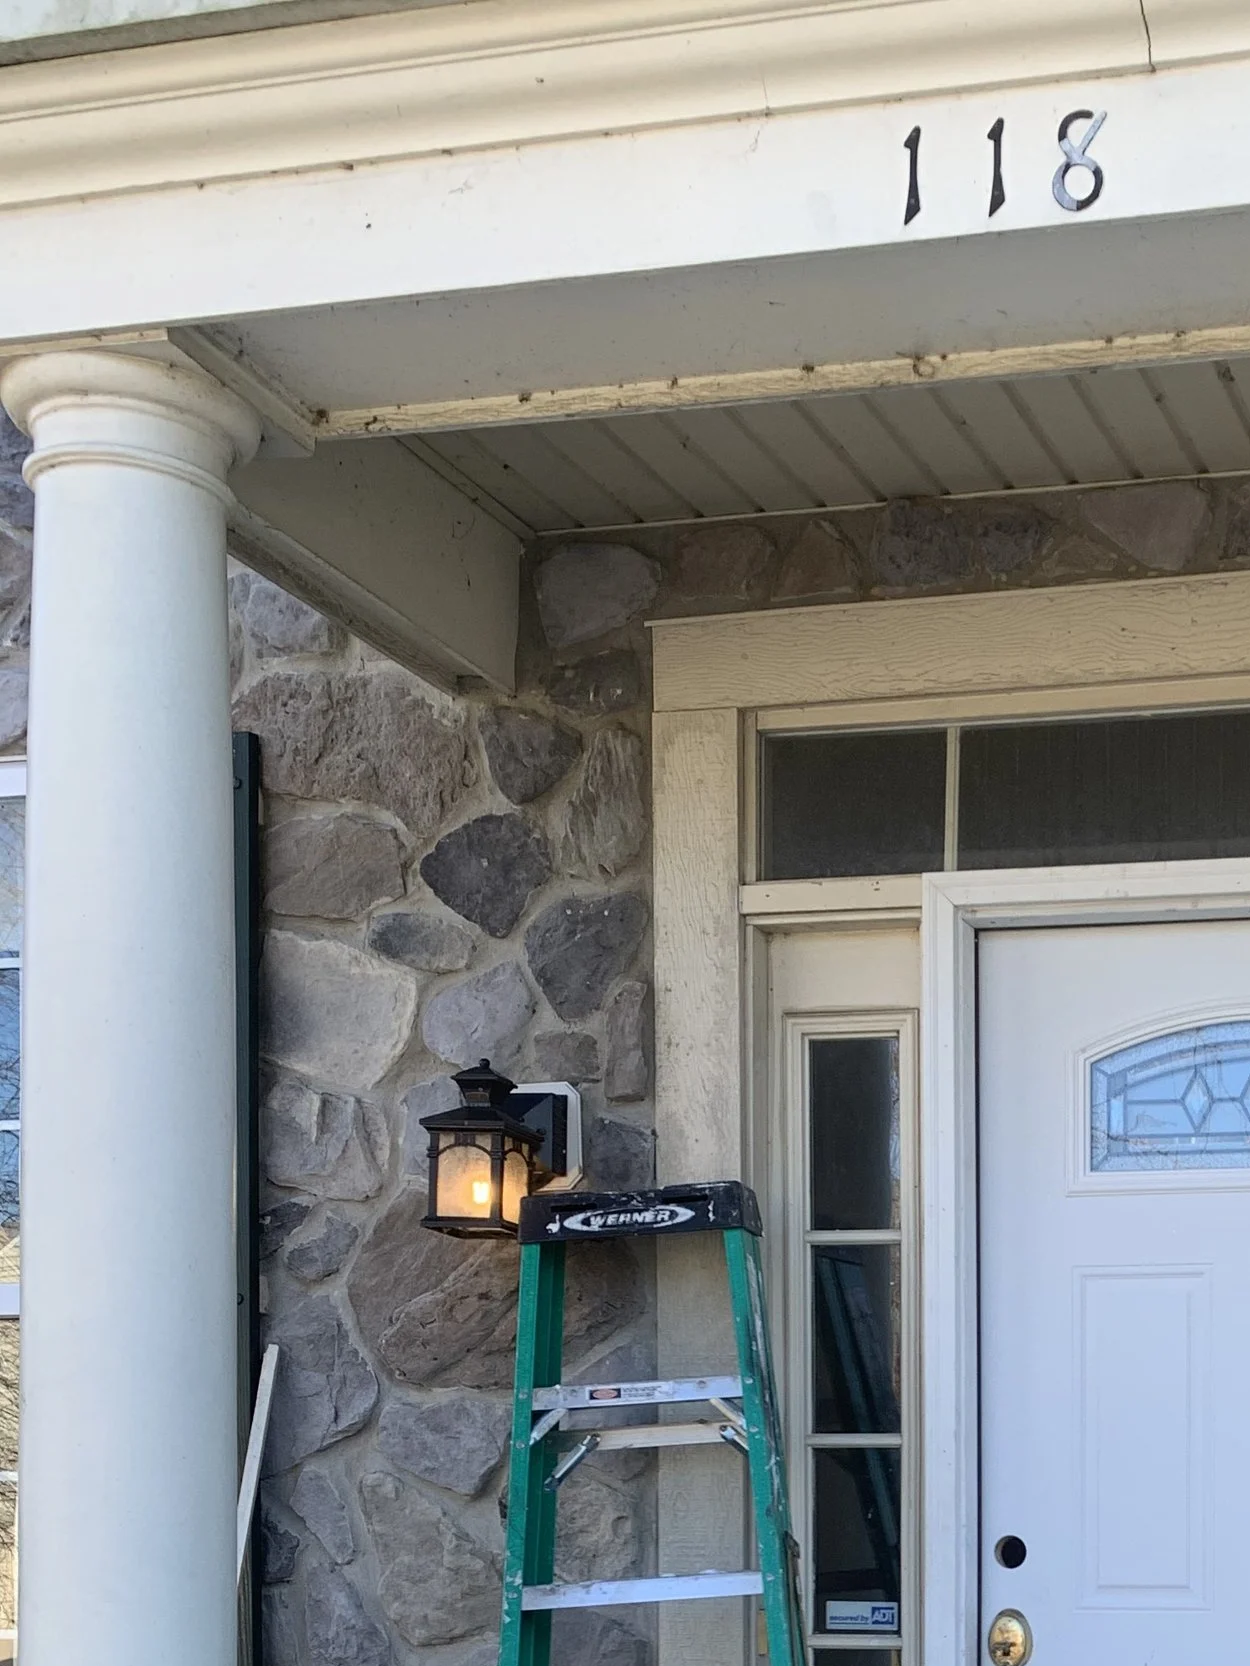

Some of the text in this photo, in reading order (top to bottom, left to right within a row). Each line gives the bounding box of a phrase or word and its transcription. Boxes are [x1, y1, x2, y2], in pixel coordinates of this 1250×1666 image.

[904, 109, 1107, 225] 118
[589, 1209, 671, 1226] WERNER
[872, 1609, 895, 1623] ADT
